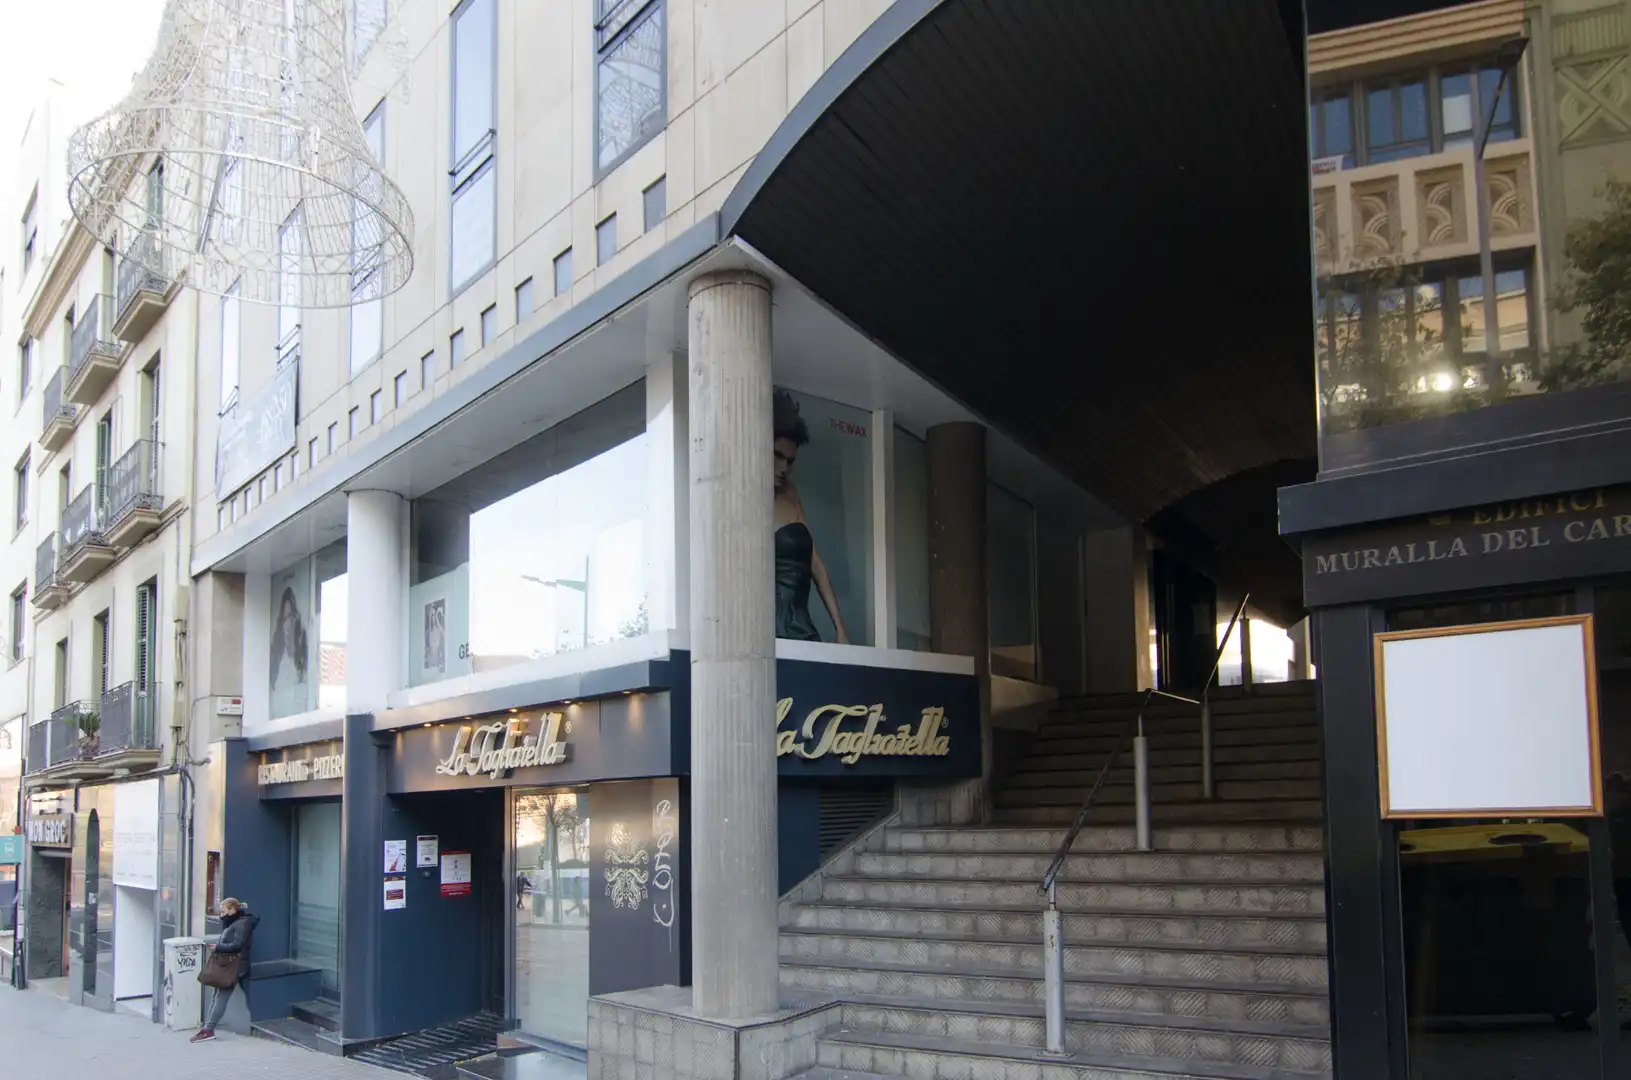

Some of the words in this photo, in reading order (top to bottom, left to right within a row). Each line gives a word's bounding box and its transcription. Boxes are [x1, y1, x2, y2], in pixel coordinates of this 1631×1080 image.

[1315, 537, 1468, 575] MURALLA
[1483, 526, 1550, 554] DEL
[435, 726, 471, 777] La
[467, 712, 567, 780] Tagliatella
[801, 703, 950, 764] Tagliatella
